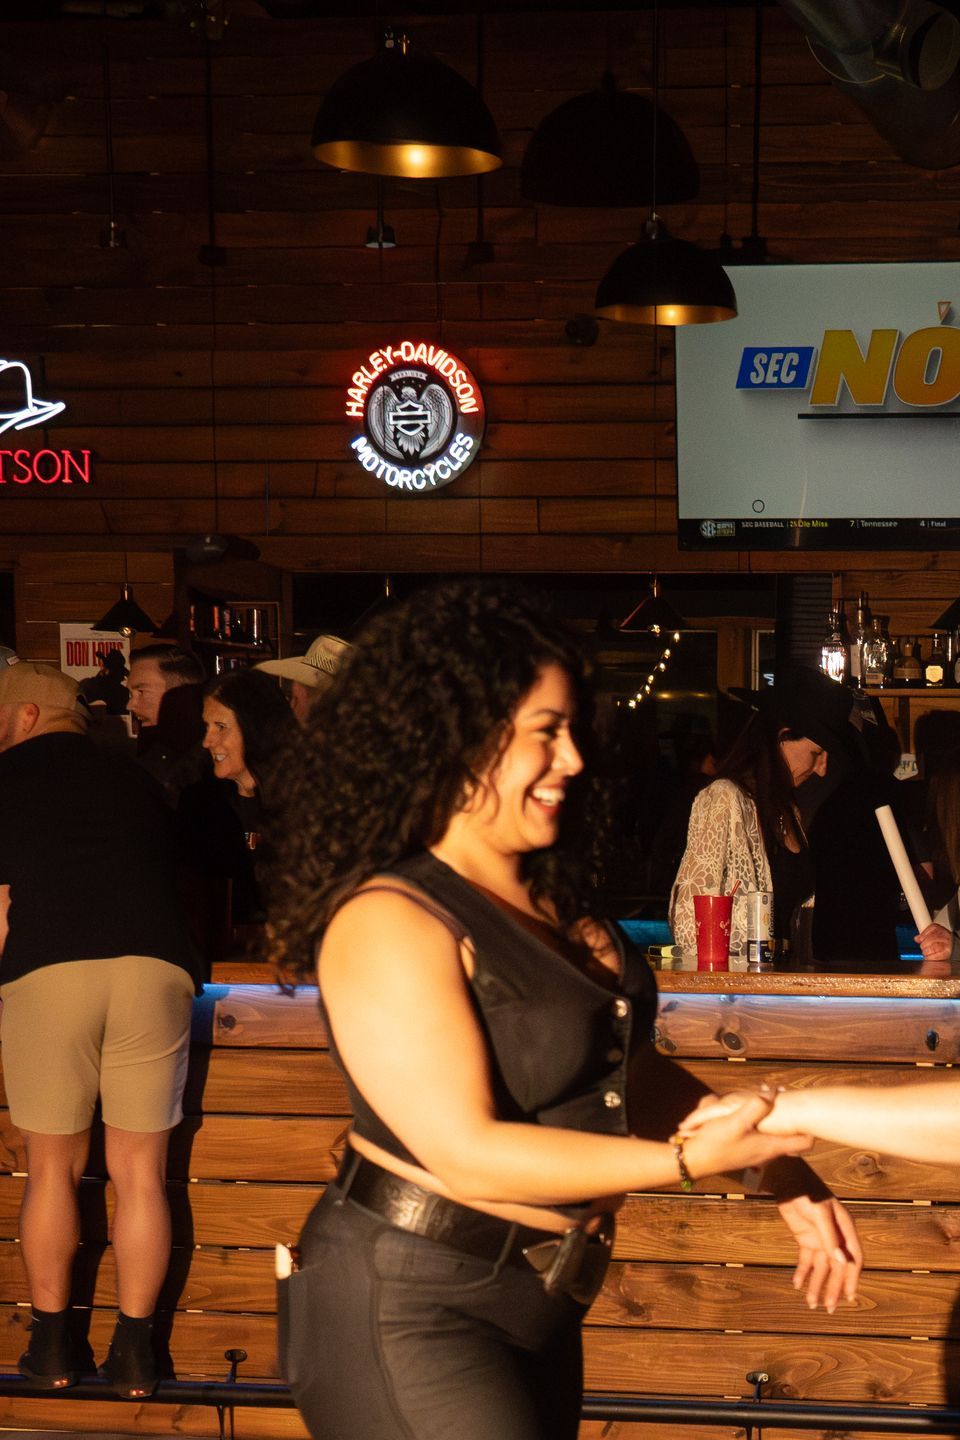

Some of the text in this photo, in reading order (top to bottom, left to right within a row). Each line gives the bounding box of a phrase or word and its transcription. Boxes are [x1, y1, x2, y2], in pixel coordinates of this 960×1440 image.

[345, 341, 479, 417] HARLEY-DAVIDSON
[750, 352, 800, 385] SEC
[351, 432, 474, 491] MOTORCYCLES
[811, 519, 829, 528] Miss
[860, 520, 898, 528] Tennessee
[66, 641, 89, 667] DON
